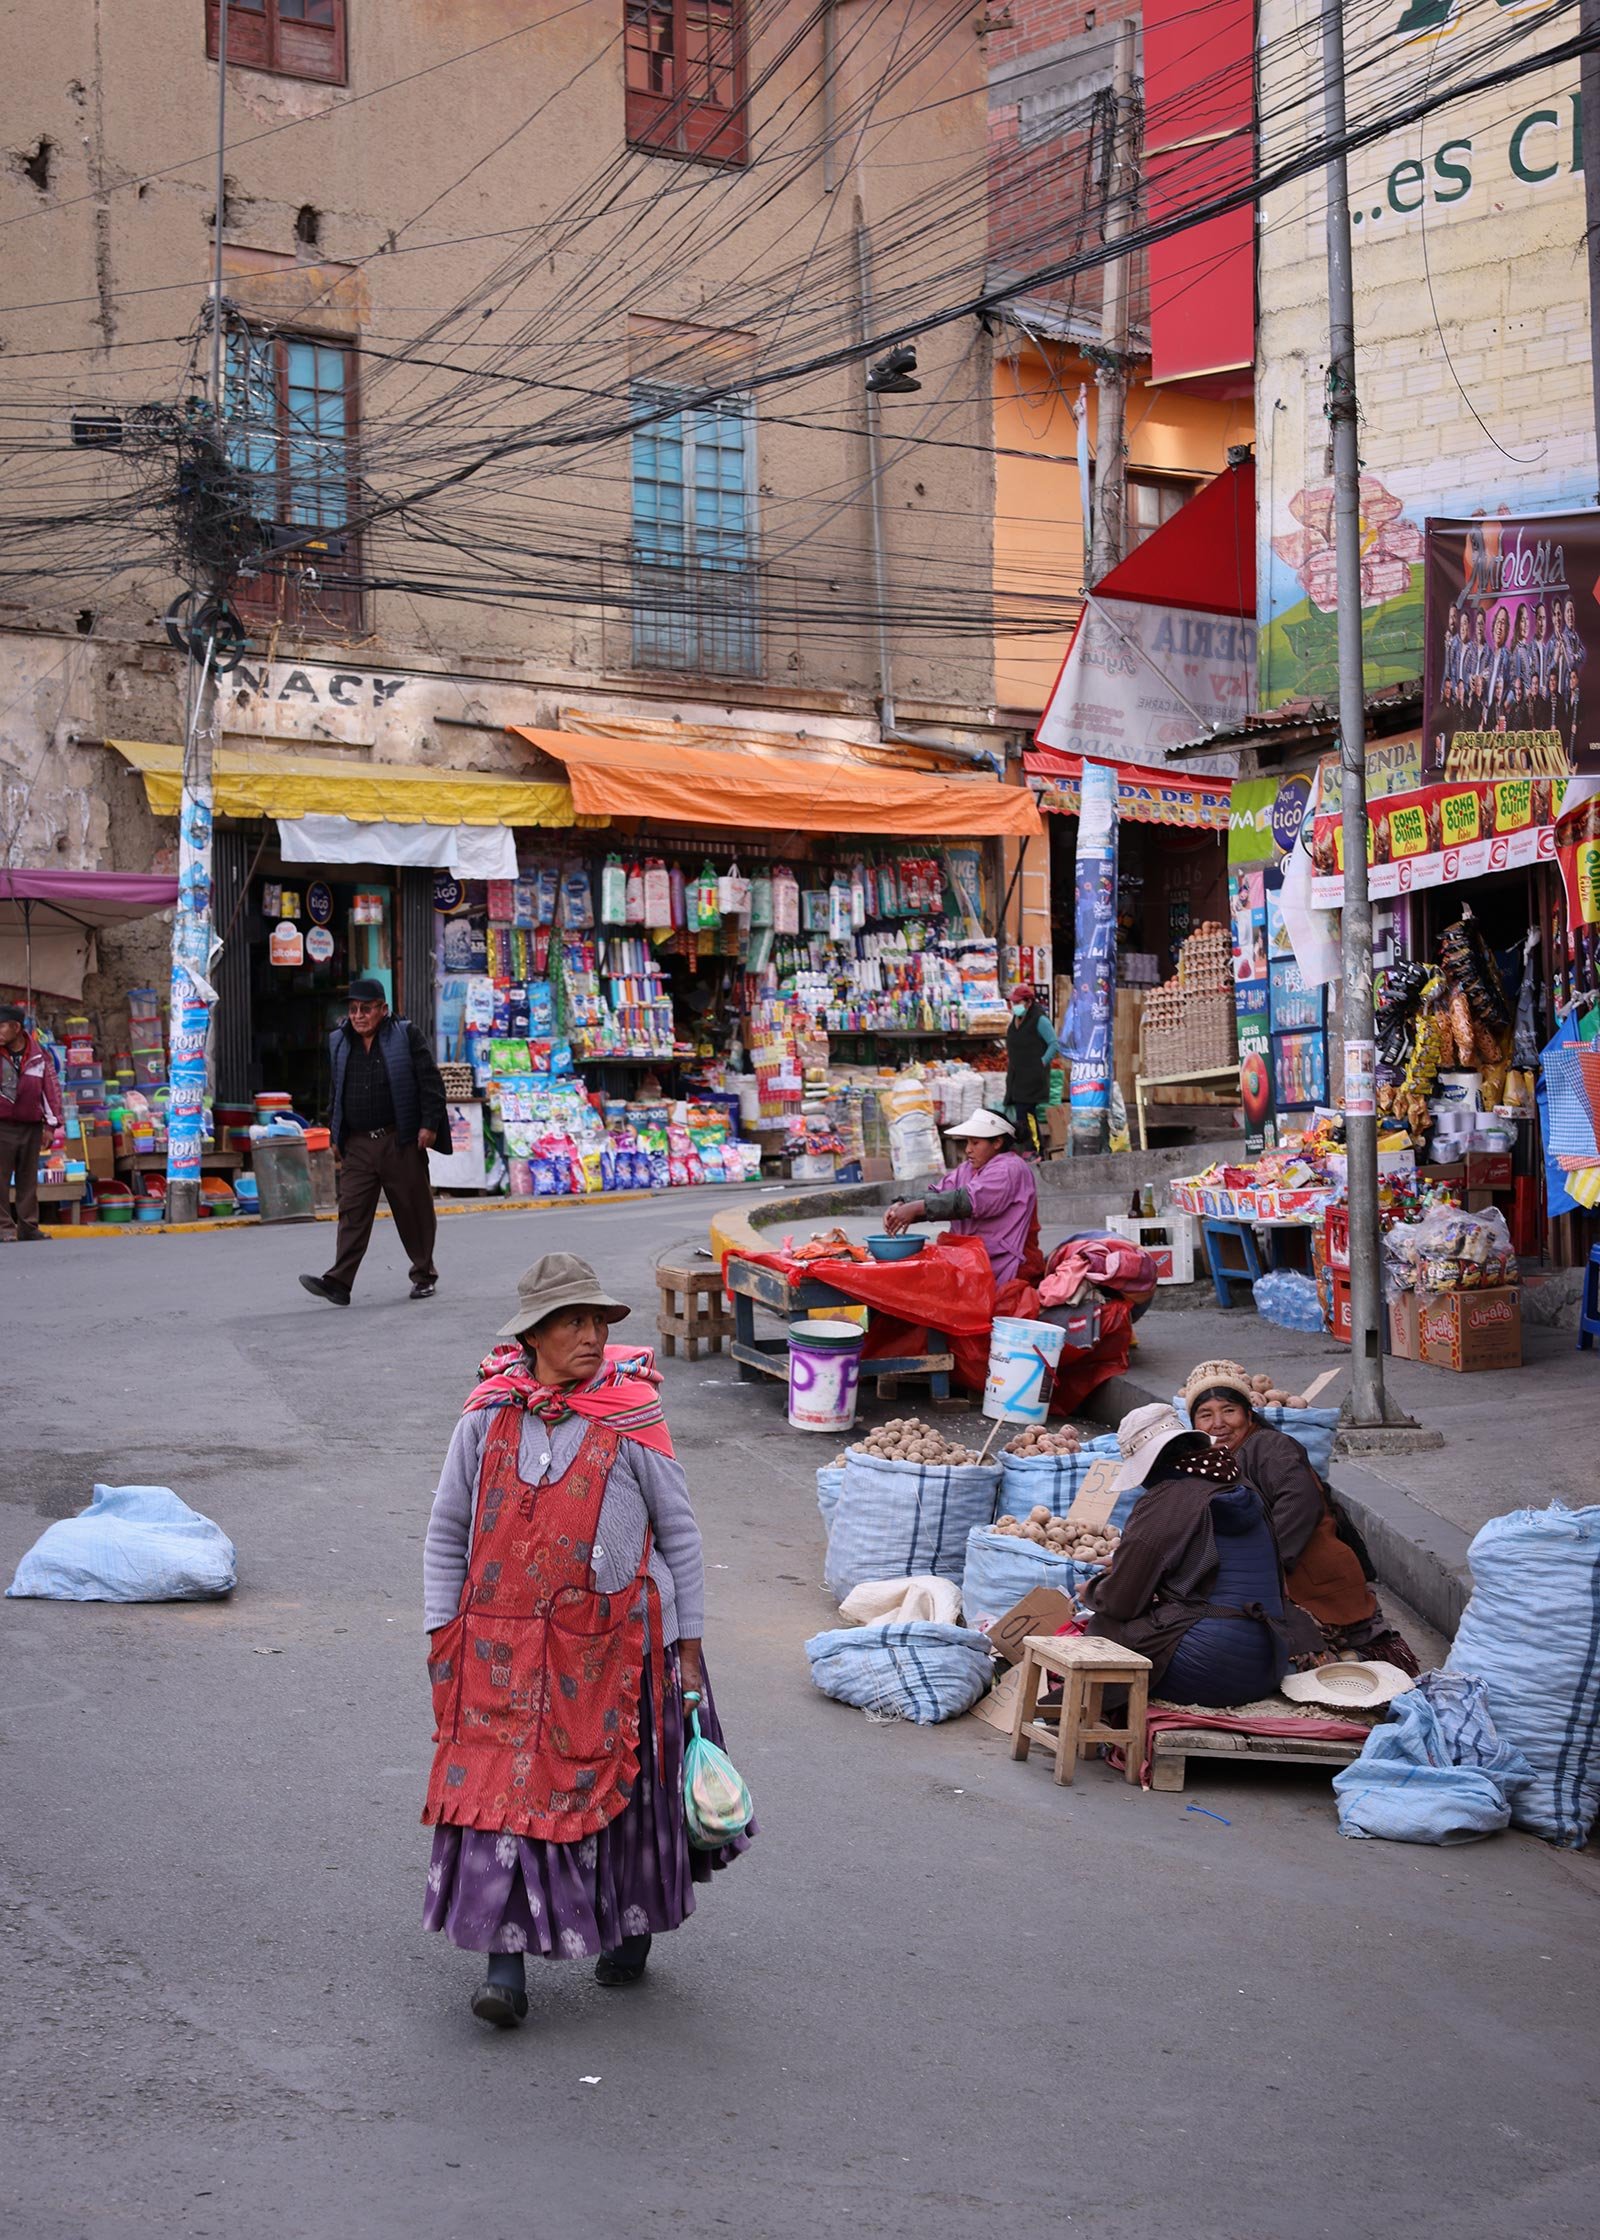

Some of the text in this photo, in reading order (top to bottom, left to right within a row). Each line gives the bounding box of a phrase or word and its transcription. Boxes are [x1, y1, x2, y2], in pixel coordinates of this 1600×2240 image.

[215, 665, 405, 707] NACK
[1161, 789, 1194, 805] DE
[1393, 911, 1402, 957] DARK
[1238, 1035, 1270, 1058] ÉCTAR
[1469, 1300, 1513, 1328] Jirafa
